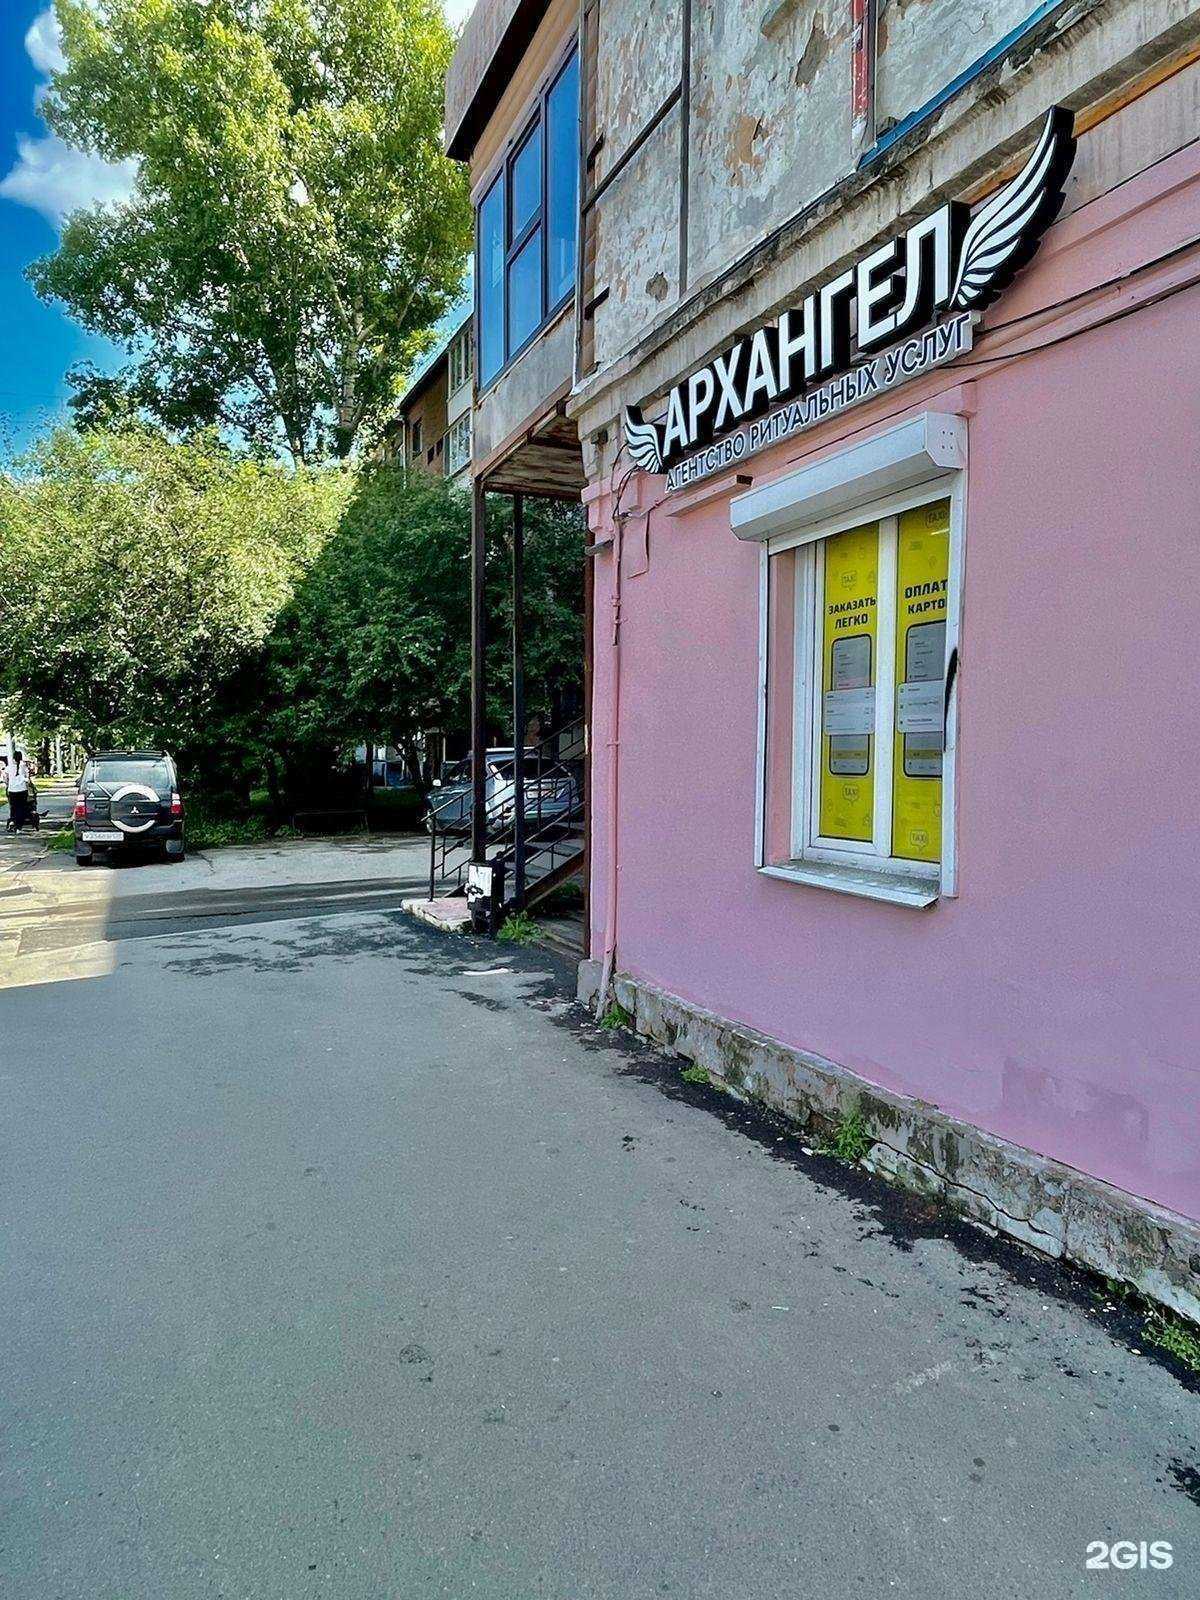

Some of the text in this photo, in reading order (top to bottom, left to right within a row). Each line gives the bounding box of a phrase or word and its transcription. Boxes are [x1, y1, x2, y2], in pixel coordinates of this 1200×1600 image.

[662, 203, 950, 458] АРХАНГЕЛ
[665, 311, 970, 493] АГЕНТСТВО РИТУАЛЬНЫХ УСЛУГ
[904, 579, 948, 598] ОПЛАТ
[828, 596, 876, 615] ЗАКАЗАТЬ
[908, 597, 947, 614] КАРТО
[835, 613, 868, 629] ЛЕГКО
